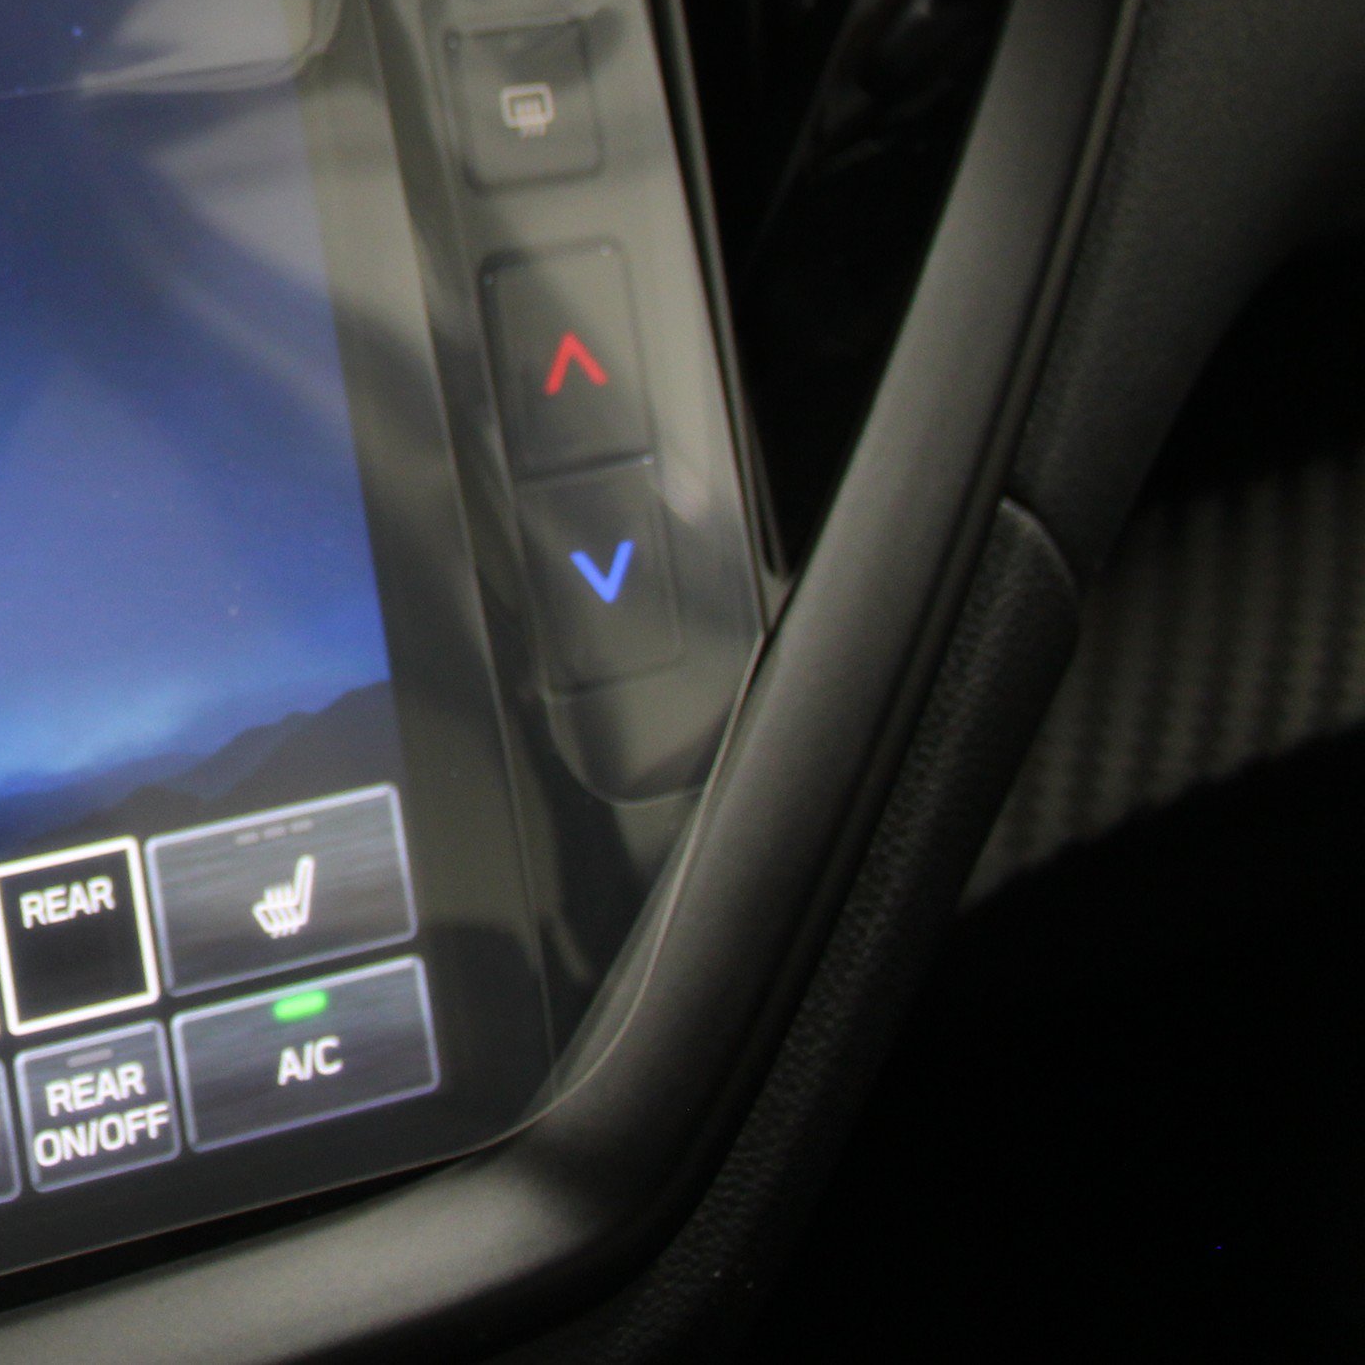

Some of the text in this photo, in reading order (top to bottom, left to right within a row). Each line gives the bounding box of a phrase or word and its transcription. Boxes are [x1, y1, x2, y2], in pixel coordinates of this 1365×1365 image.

[20, 876, 115, 928] REAR
[278, 1036, 342, 1085] A/C
[44, 1061, 146, 1116] REAR
[32, 1101, 170, 1168] ON/OFF
